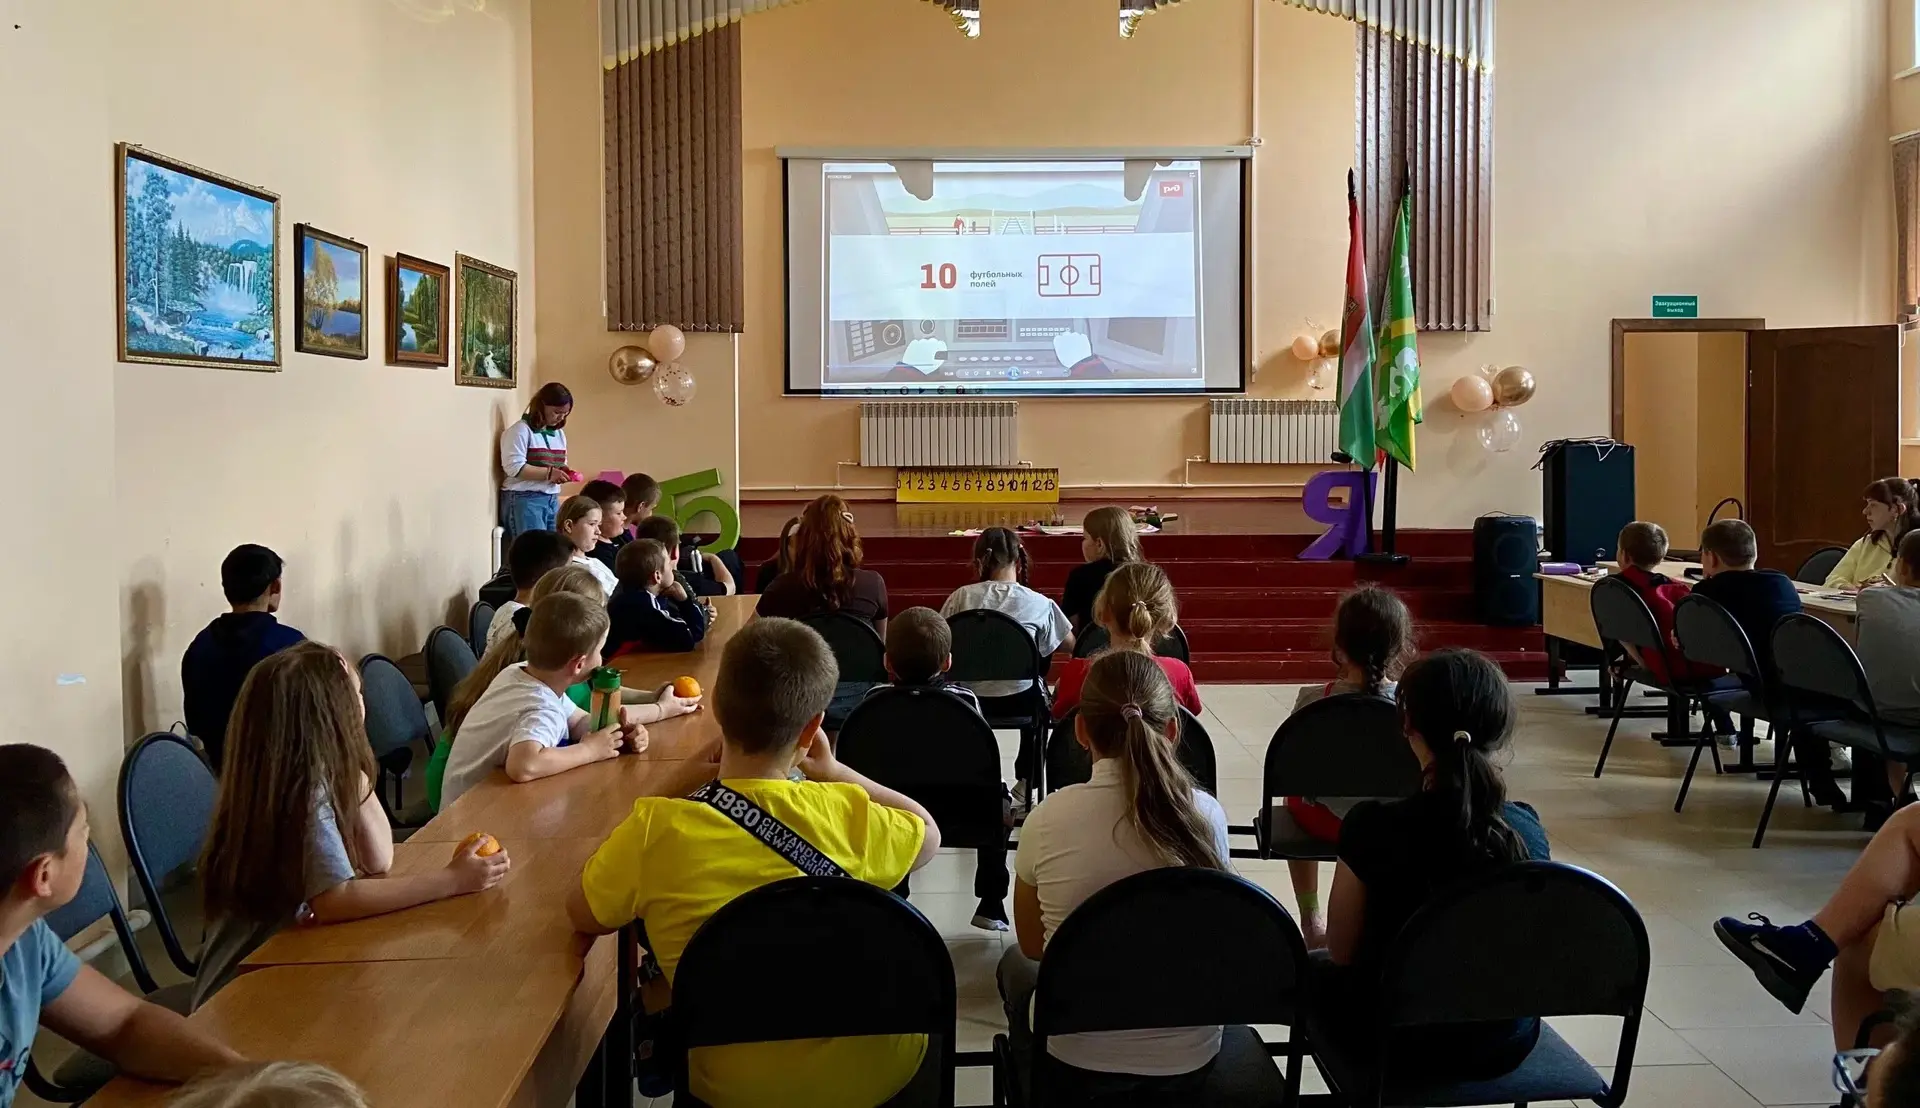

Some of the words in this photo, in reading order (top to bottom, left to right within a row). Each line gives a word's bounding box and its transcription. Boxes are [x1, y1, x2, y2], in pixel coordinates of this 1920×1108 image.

[920, 263, 957, 289] 10
[970, 270, 1023, 280] футбольных
[970, 280, 997, 288] полей
[906, 480, 912, 490] 1
[917, 479, 924, 490] 2
[928, 480, 936, 491] 3
[940, 480, 948, 490] 4
[951, 480, 960, 491] 5
[964, 480, 971, 491] 6
[975, 480, 982, 491] 7
[985, 480, 995, 491] 8
[998, 480, 1005, 491] 9
[1007, 480, 1018, 491] 10
[1021, 480, 1028, 491] 11
[1032, 480, 1042, 491] 12
[1043, 480, 1055, 491] 13
[711, 787, 762, 828] 1980
